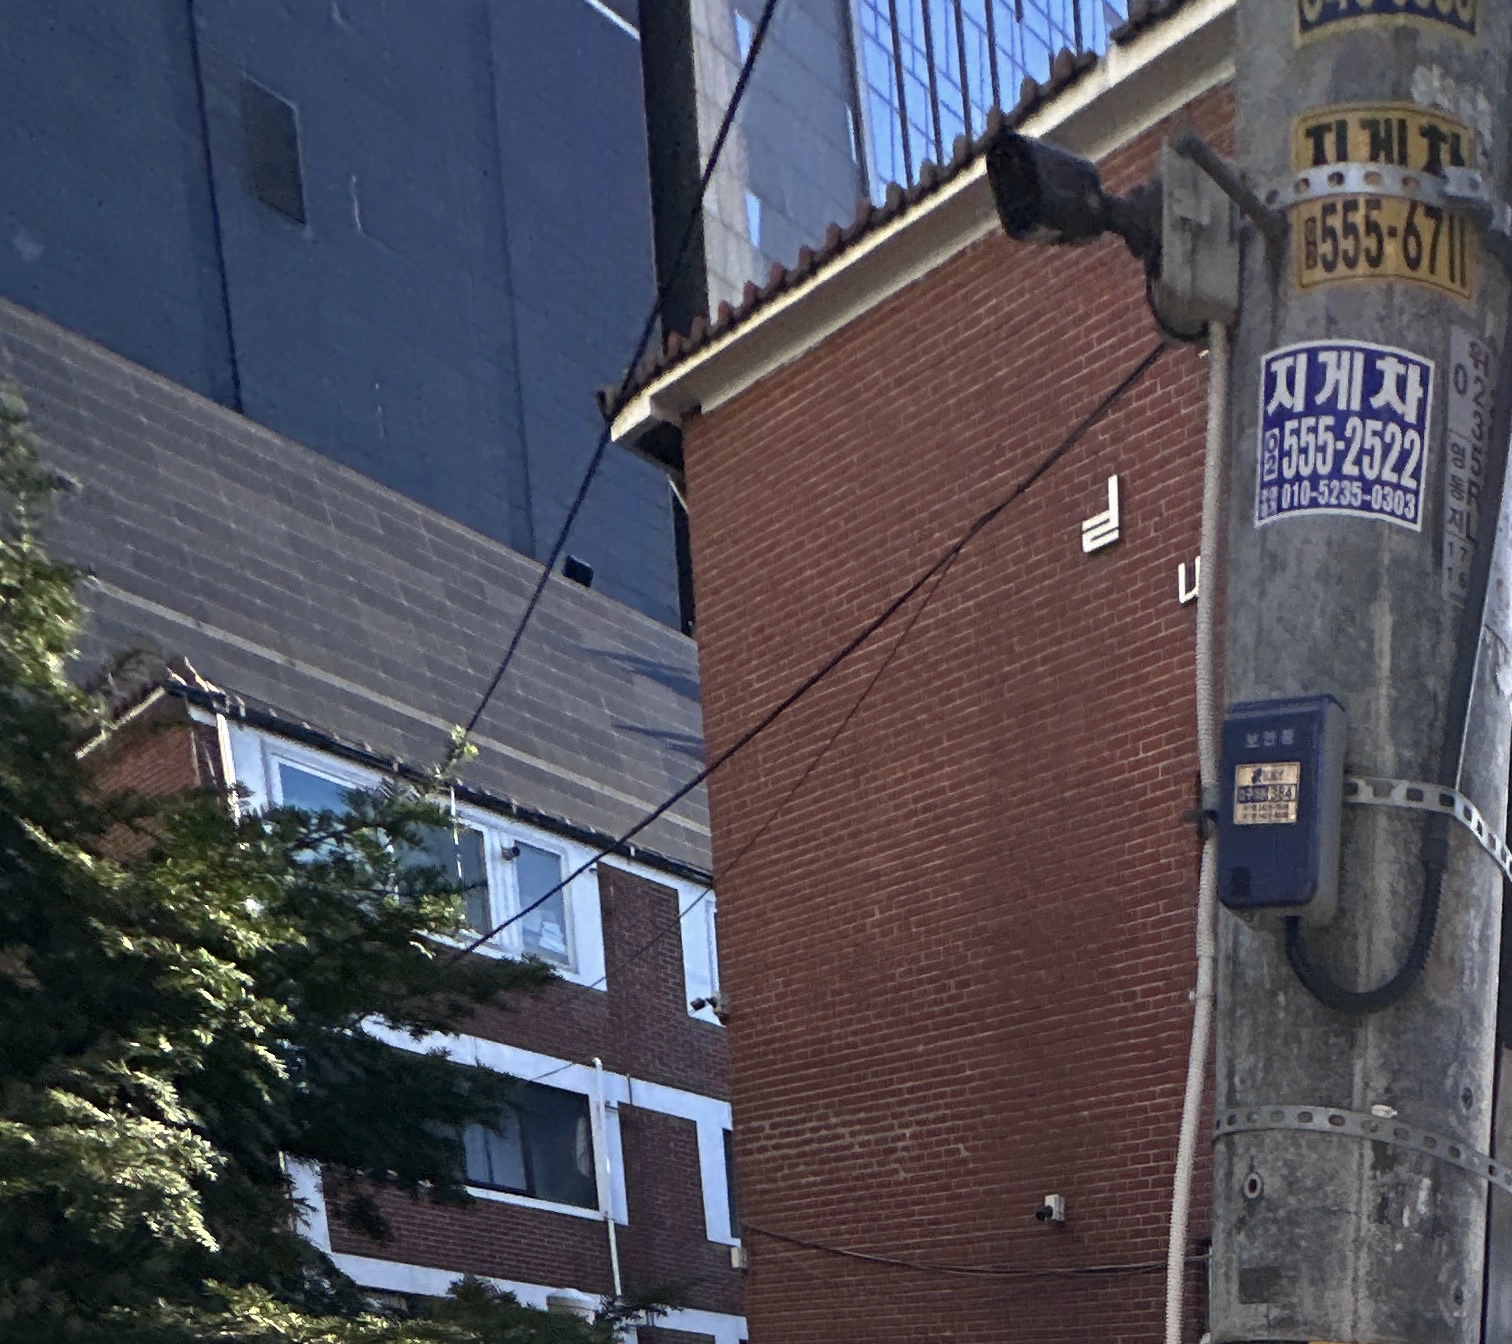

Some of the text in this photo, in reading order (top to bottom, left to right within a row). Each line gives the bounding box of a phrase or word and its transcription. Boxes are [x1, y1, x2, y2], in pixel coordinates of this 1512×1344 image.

[1266, 351, 1424, 424] 지게차
[1282, 415, 1421, 490] 555-2522
[1281, 480, 1416, 520] 010-5235-0303
